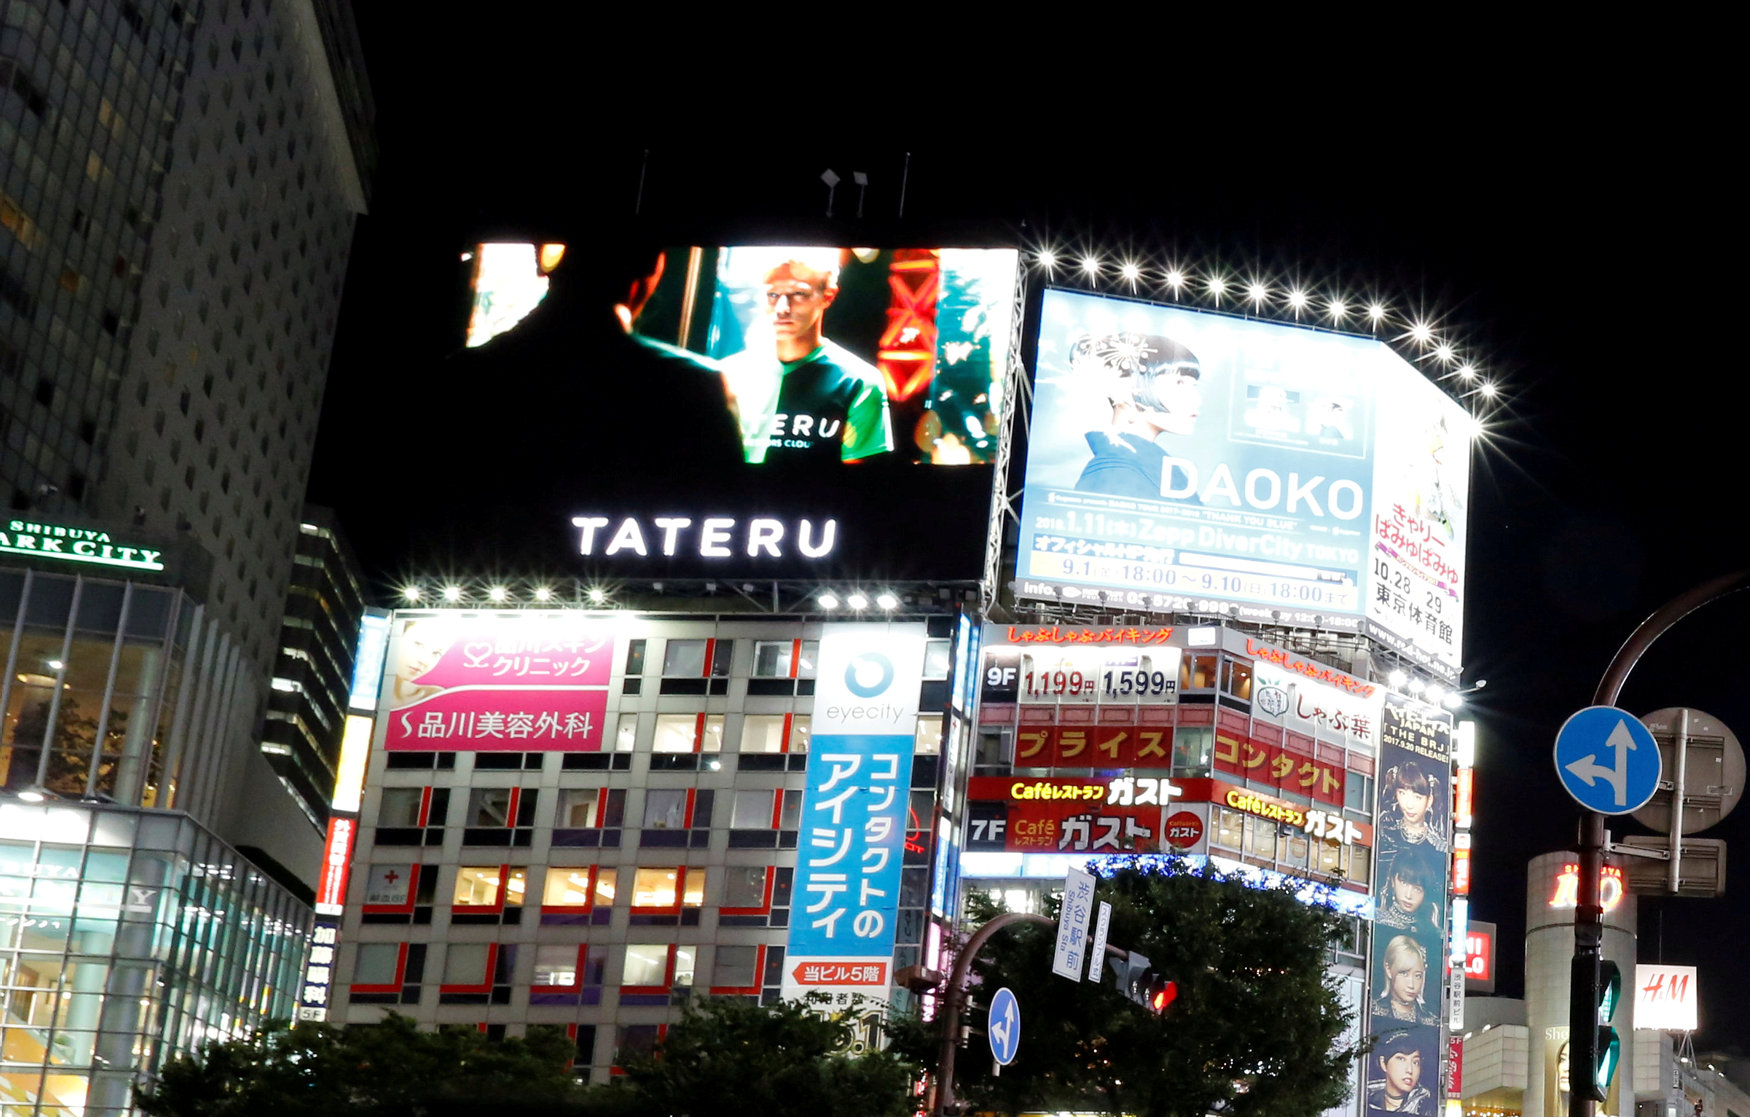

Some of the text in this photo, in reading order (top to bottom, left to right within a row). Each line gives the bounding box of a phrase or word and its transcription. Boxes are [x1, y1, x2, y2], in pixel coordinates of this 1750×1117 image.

[783, 439, 815, 449] CLOU
[1159, 455, 1363, 520] DAOKO
[10, 520, 110, 543] SHIBUYA
[571, 517, 838, 559] TATERU
[1393, 503, 1445, 547] きゃりー
[73, 541, 161, 563] CITY
[1139, 518, 1195, 547] Zepp
[1198, 526, 1303, 561] DiverCity
[1306, 543, 1359, 564] TOKYO
[1375, 513, 1459, 584] ぱみゅぱみゅ
[1376, 581, 1453, 646] 東京体育館
[1426, 591, 1442, 614] 29
[1007, 626, 1173, 644] しゃぶしゃぶバイキング
[492, 656, 591, 677] クリニック
[987, 667, 1016, 686] 9F
[1247, 638, 1376, 698] しゃぶしゃぶバイキング
[1025, 671, 1094, 700] 1,199円
[1103, 670, 1176, 699] 1,599円
[417, 711, 593, 739] 品川美容外科
[826, 704, 904, 724] eyecity
[1296, 692, 1371, 739] しゃぶ葉
[1400, 718, 1435, 738] JAPAN
[1019, 730, 1167, 759] プライス
[1215, 734, 1341, 794] コンタクト
[1107, 777, 1182, 806] ガスト
[971, 819, 1006, 841] 7F
[1014, 819, 1055, 836] Café
[1014, 836, 1053, 846] レストラン
[1059, 815, 1150, 851] ガスト
[1169, 827, 1201, 838] ガスト
[1304, 809, 1362, 845] ガスト
[806, 754, 862, 939] アイシティ
[853, 754, 899, 939] コンタクトの
[1064, 889, 1075, 930] Shibuya
[803, 965, 880, 983] 当ビル5階
[1642, 972, 1689, 1002] H&M
[303, 1009, 321, 1020] 5F
[1450, 1037, 1462, 1045] 5F
